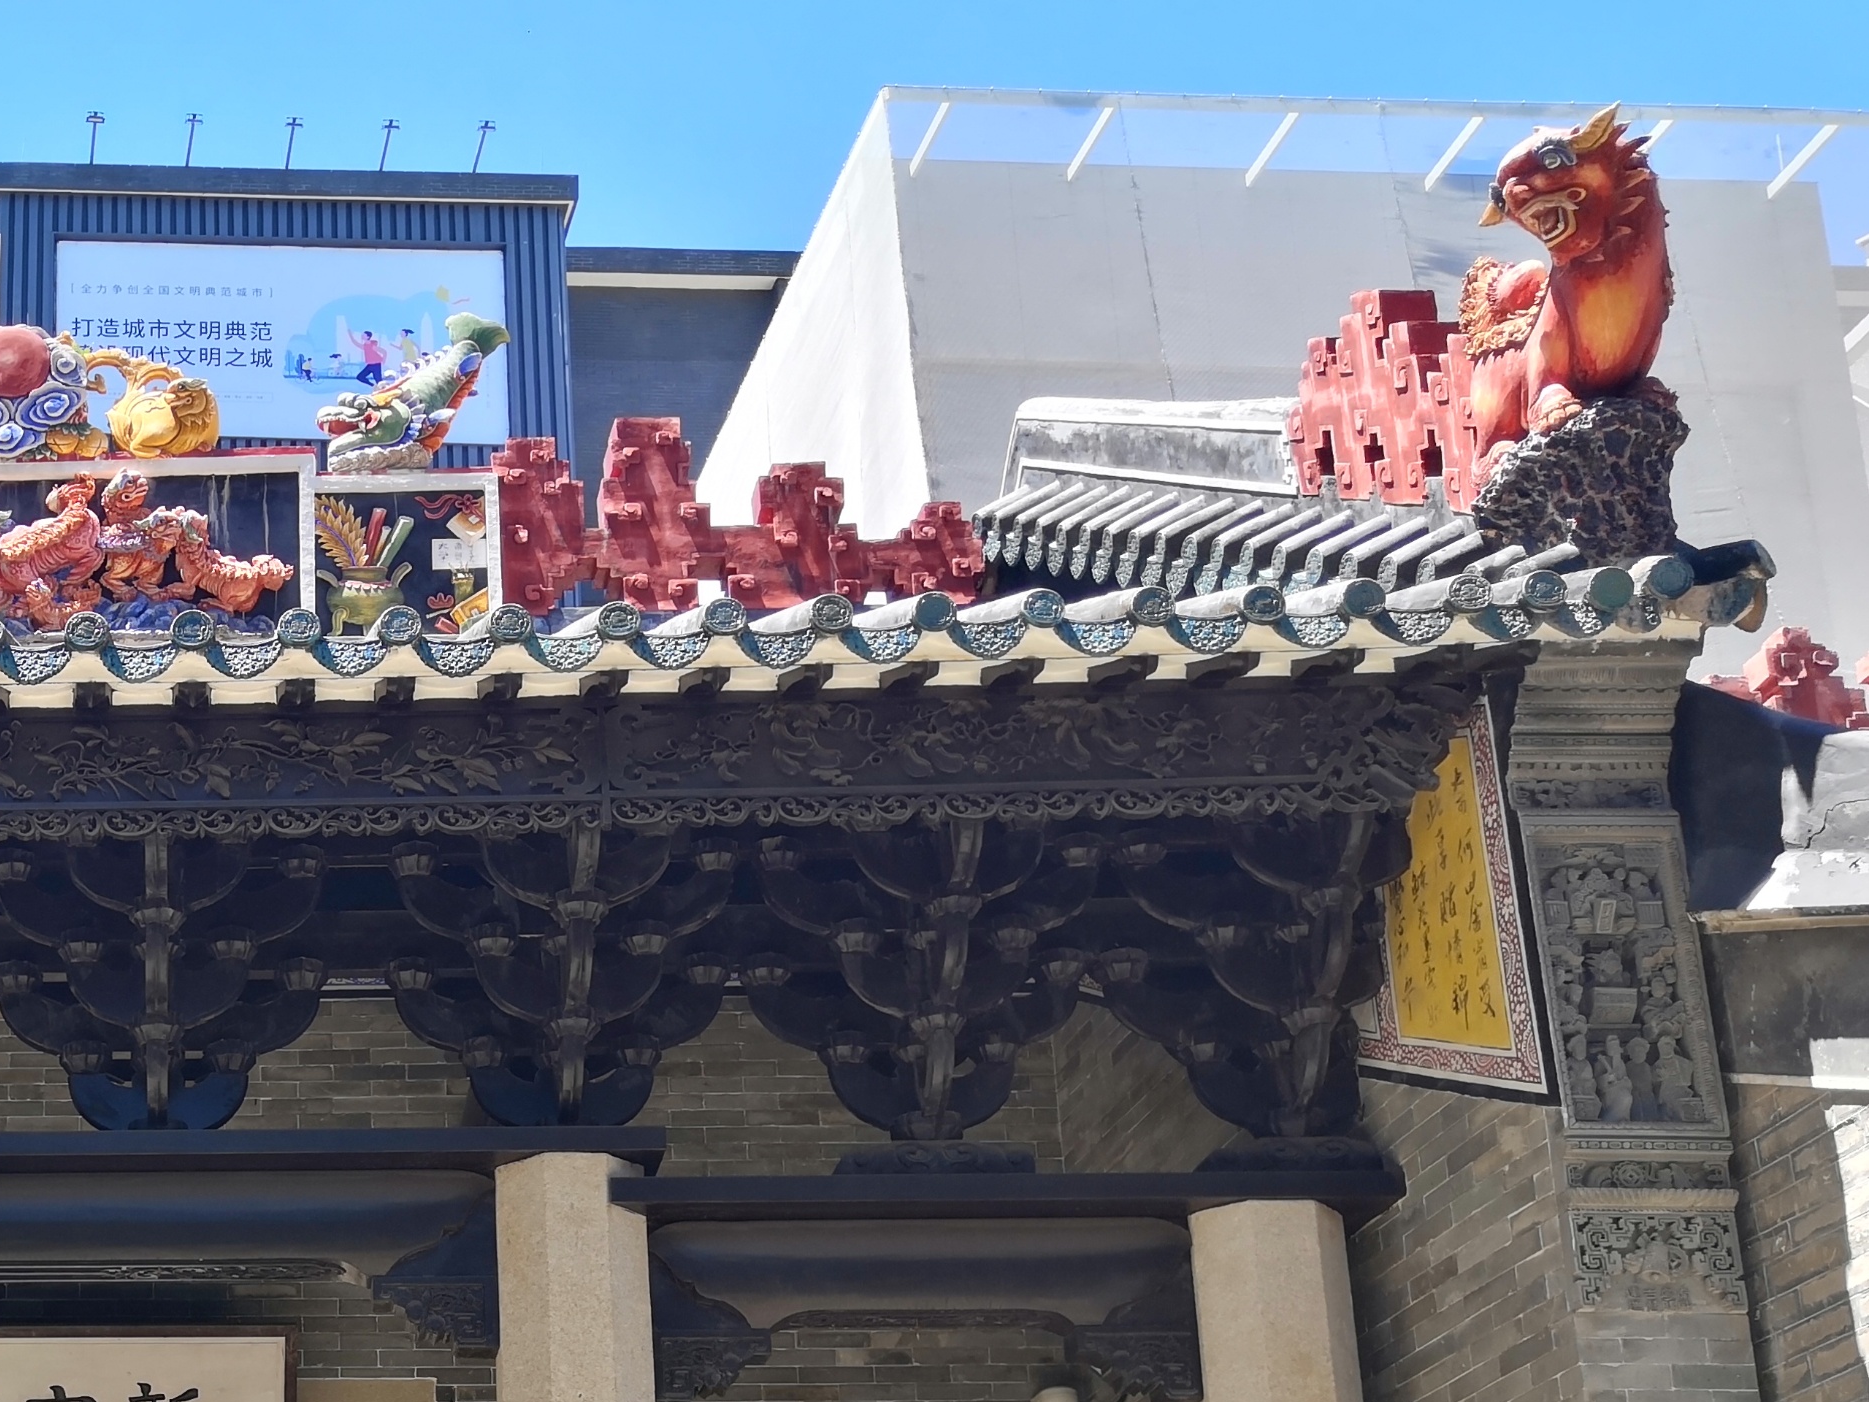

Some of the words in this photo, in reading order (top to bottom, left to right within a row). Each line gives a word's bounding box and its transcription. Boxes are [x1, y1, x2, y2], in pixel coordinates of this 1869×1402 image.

[71, 317, 273, 341] 打造城市文明典范
[79, 344, 273, 368] 现代文明之城
